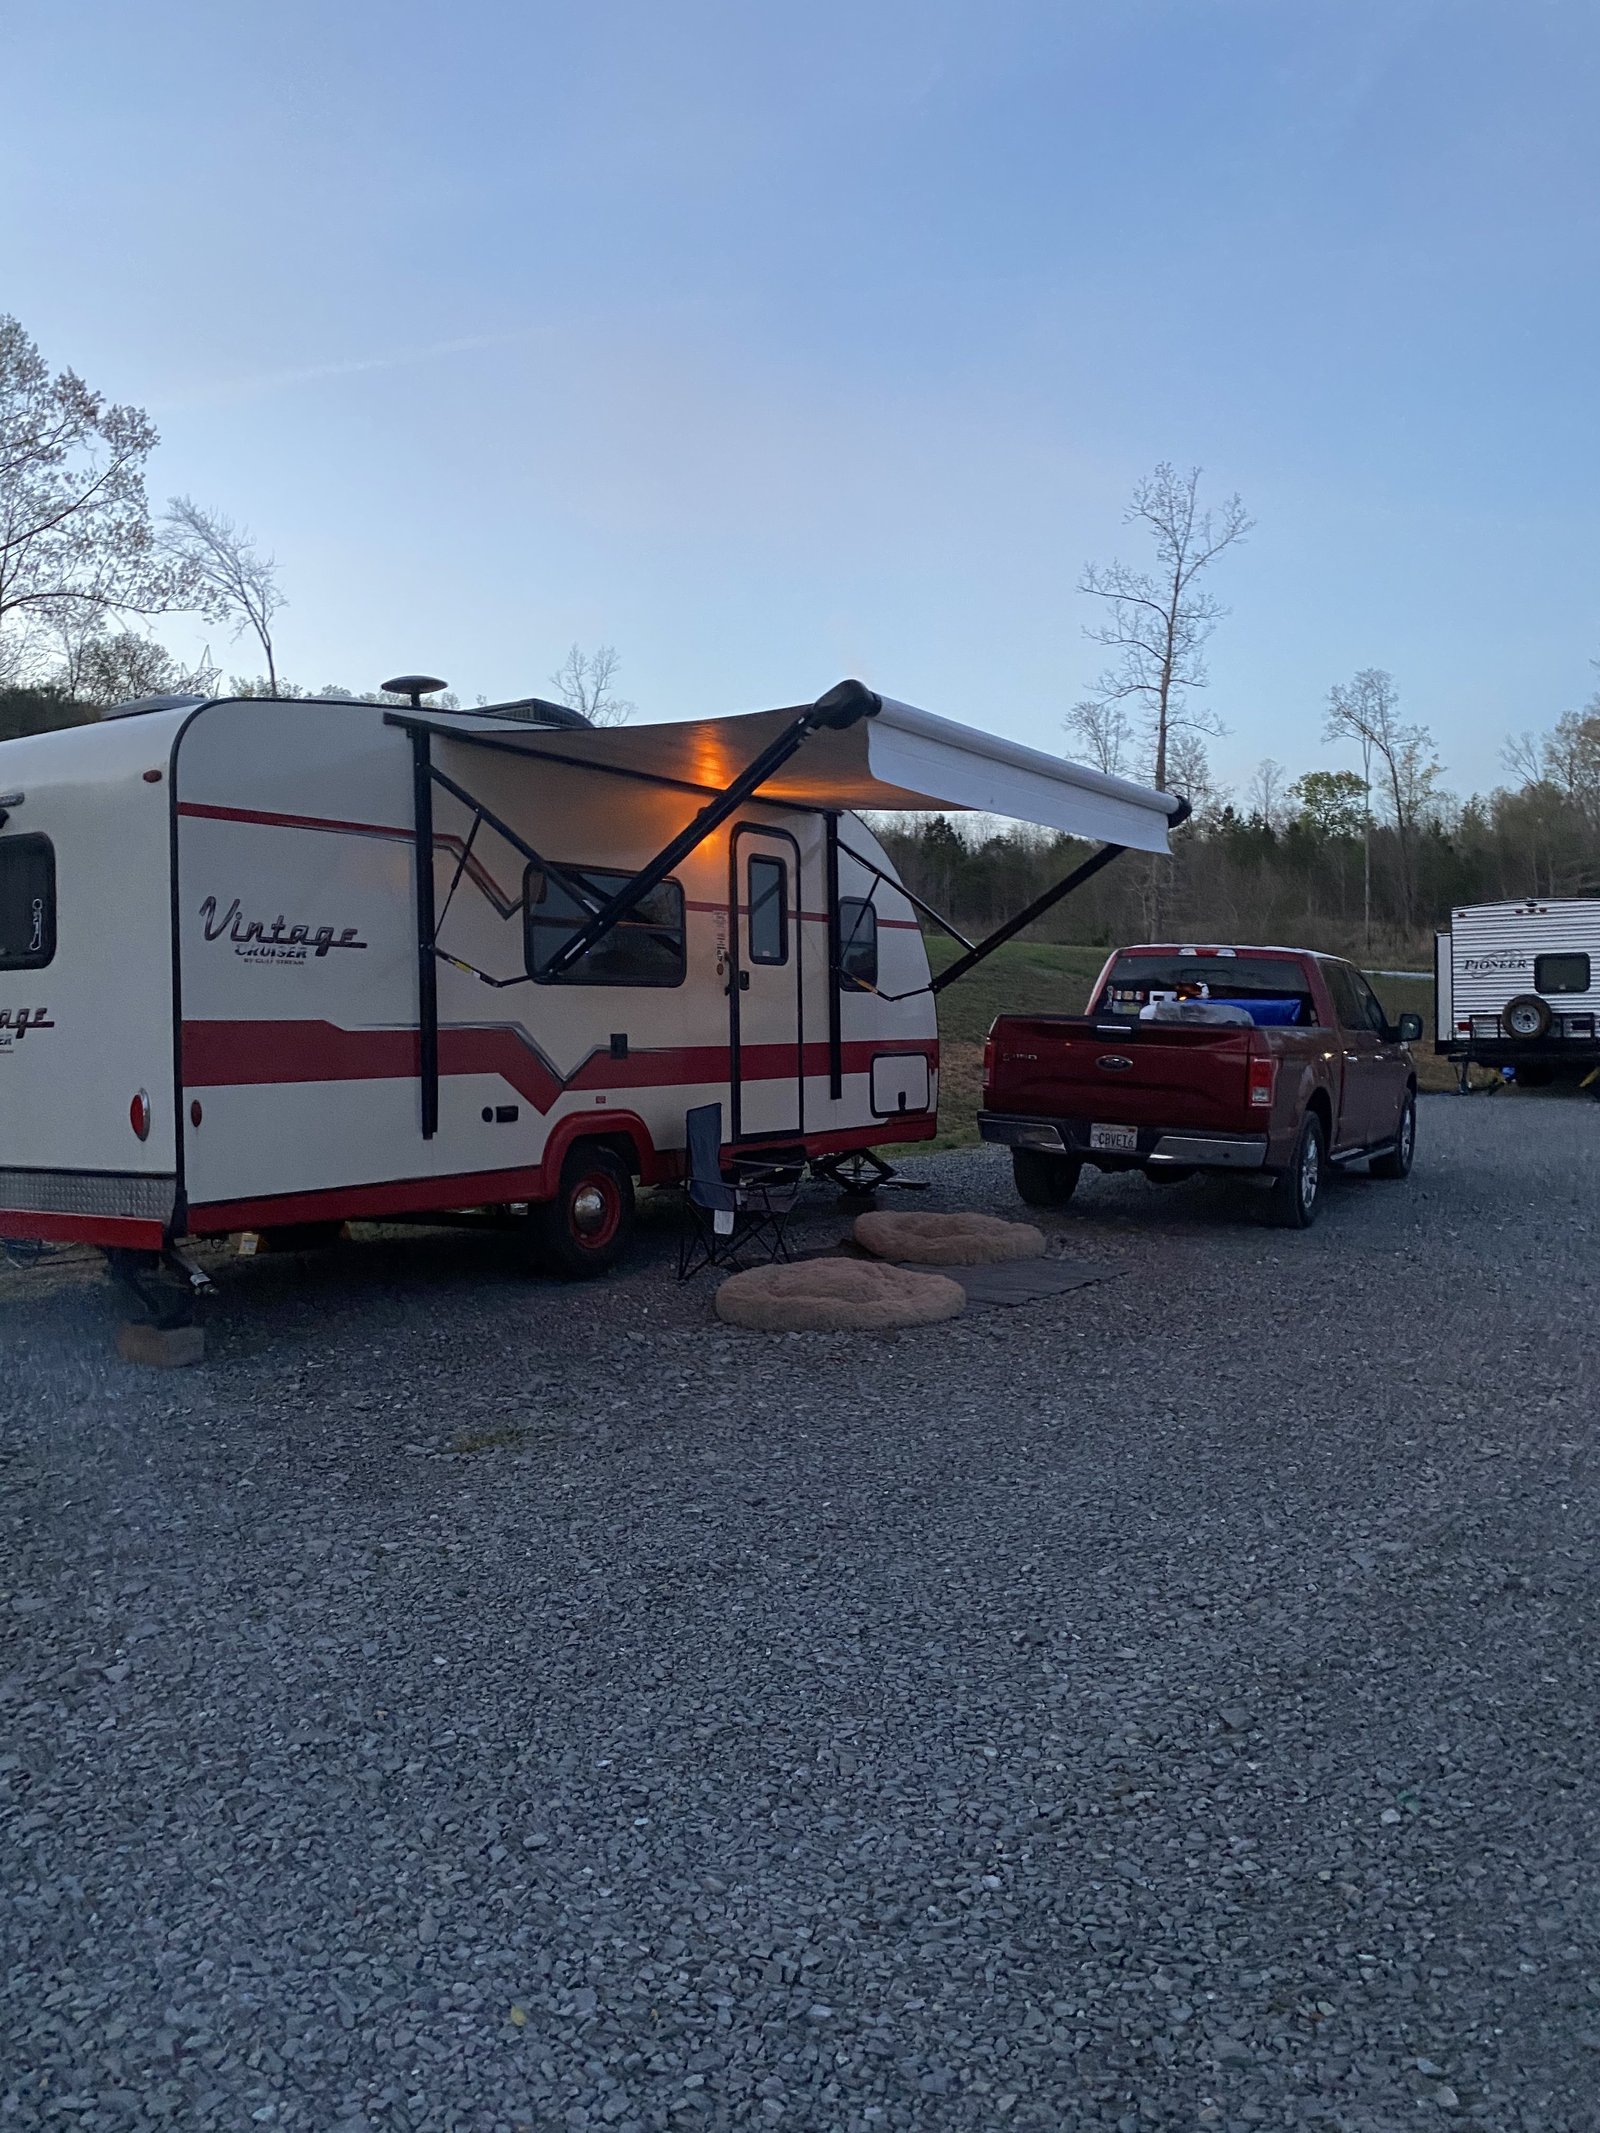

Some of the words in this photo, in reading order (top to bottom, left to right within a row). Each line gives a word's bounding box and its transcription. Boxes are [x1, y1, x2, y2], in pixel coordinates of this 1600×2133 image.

[198, 895, 368, 957] Vintage
[234, 944, 308, 959] CRUISER
[1464, 959, 1527, 970] PIONEER
